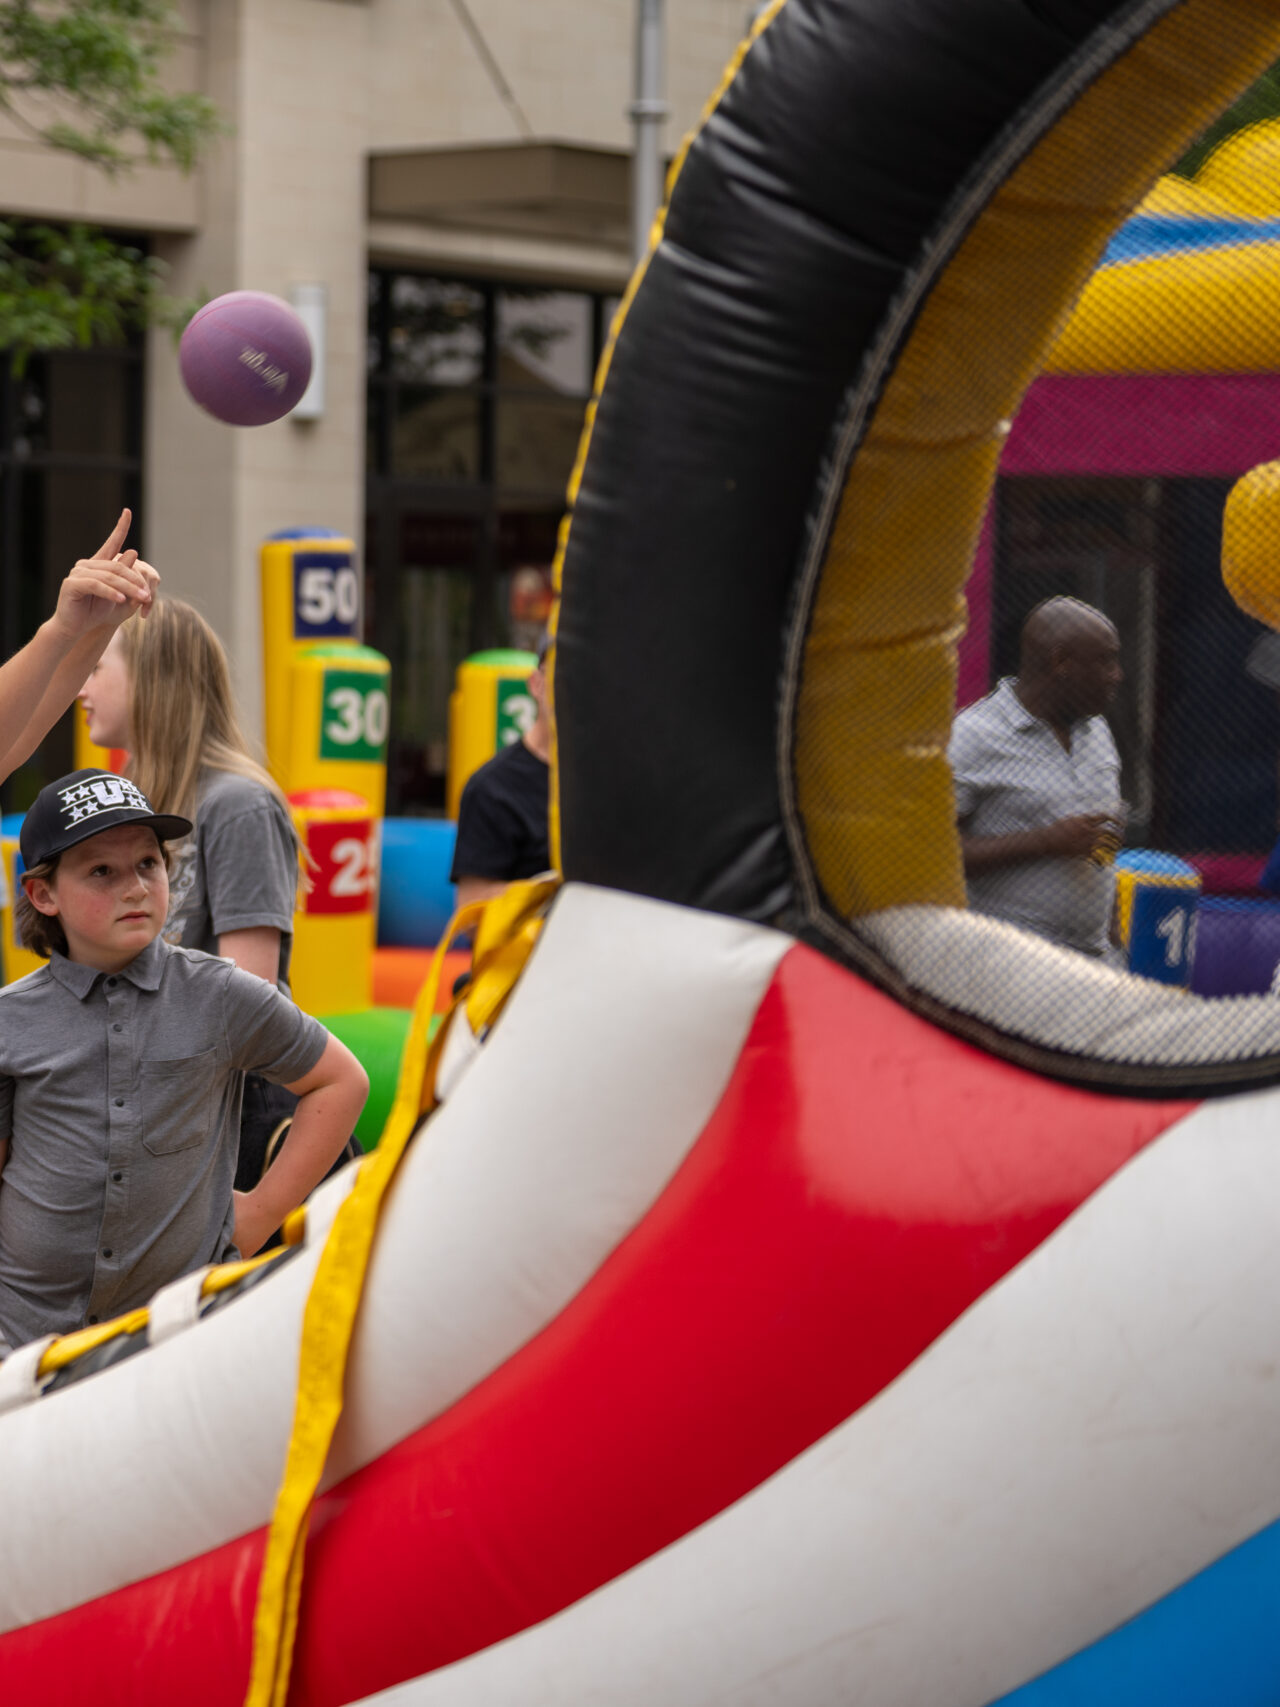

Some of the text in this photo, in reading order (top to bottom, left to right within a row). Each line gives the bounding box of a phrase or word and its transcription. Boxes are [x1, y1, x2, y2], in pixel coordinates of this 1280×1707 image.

[298, 567, 358, 624] 50
[325, 687, 388, 746] 30
[502, 694, 538, 746] 3
[90, 780, 125, 807] U
[330, 837, 376, 896] 2
